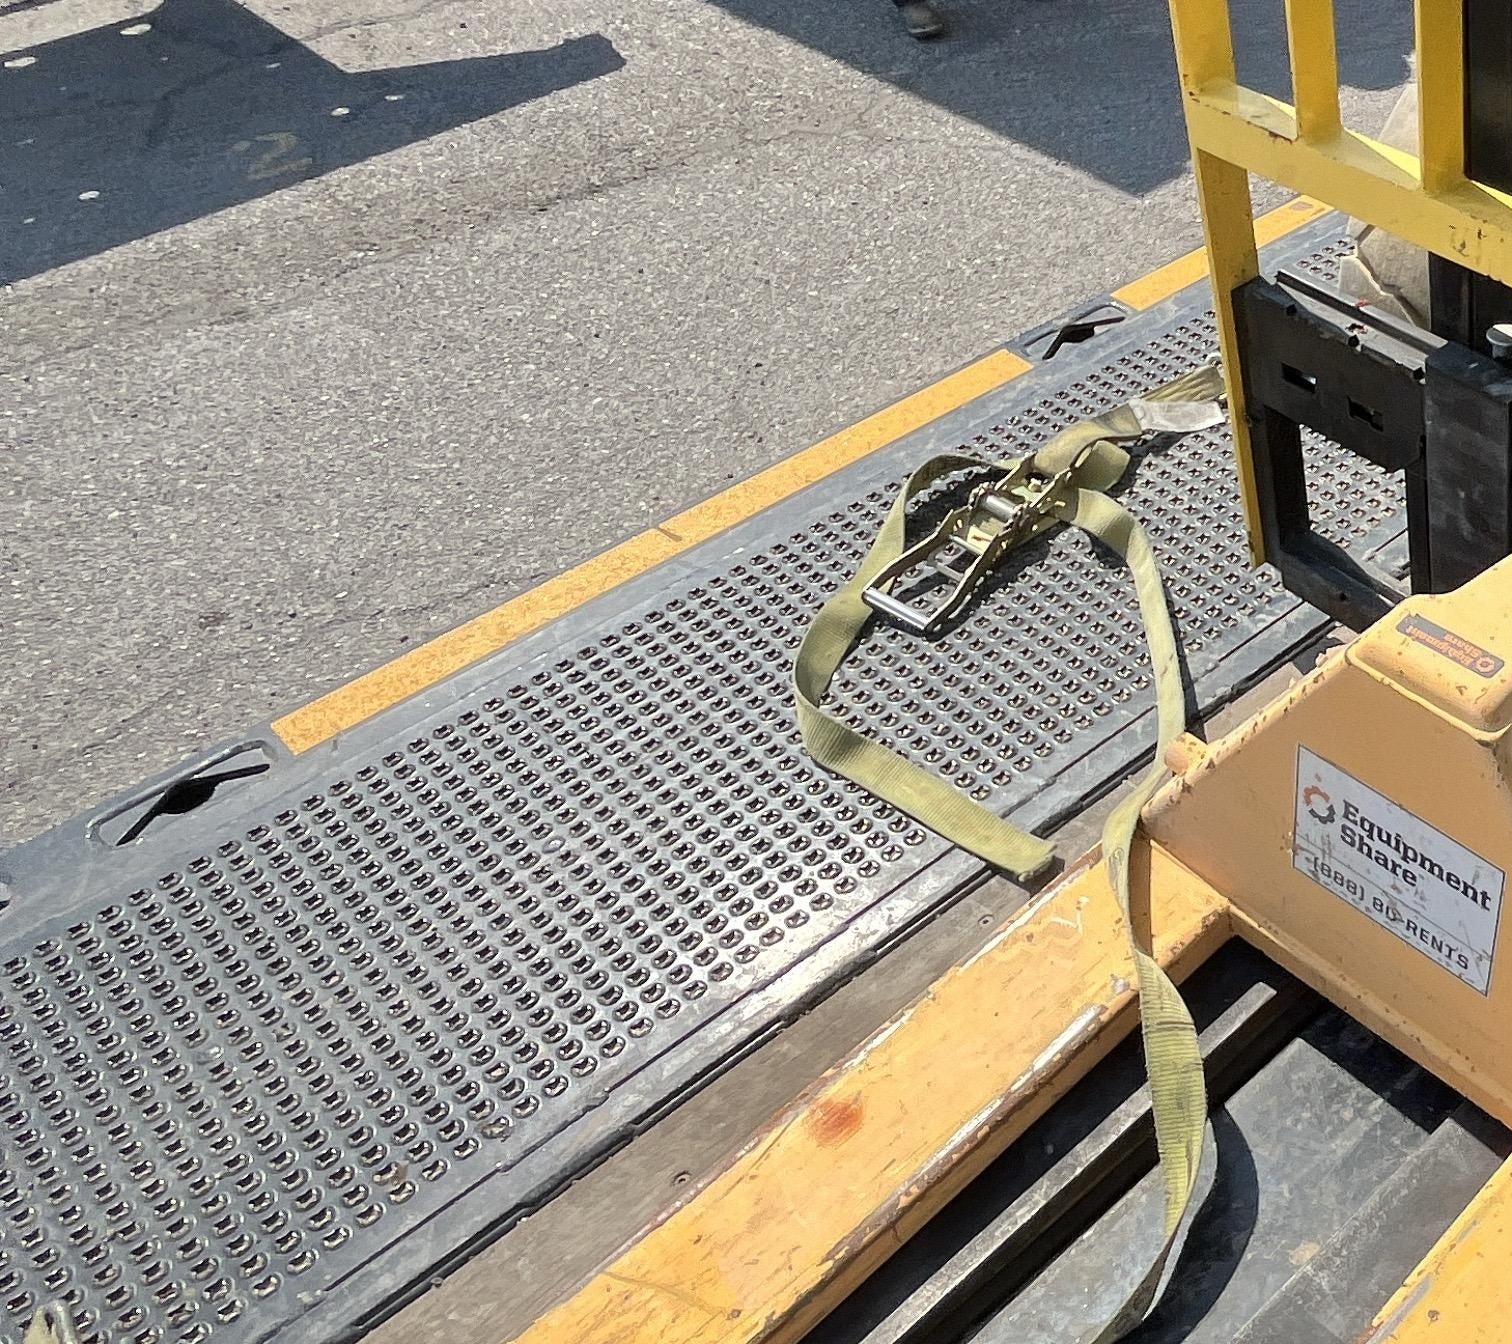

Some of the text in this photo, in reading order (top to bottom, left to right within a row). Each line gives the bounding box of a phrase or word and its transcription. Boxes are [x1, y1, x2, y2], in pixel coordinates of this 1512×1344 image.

[1311, 855, 1365, 901] (888)
[1339, 827, 1419, 888] Share
[1341, 799, 1492, 912] Equipment
